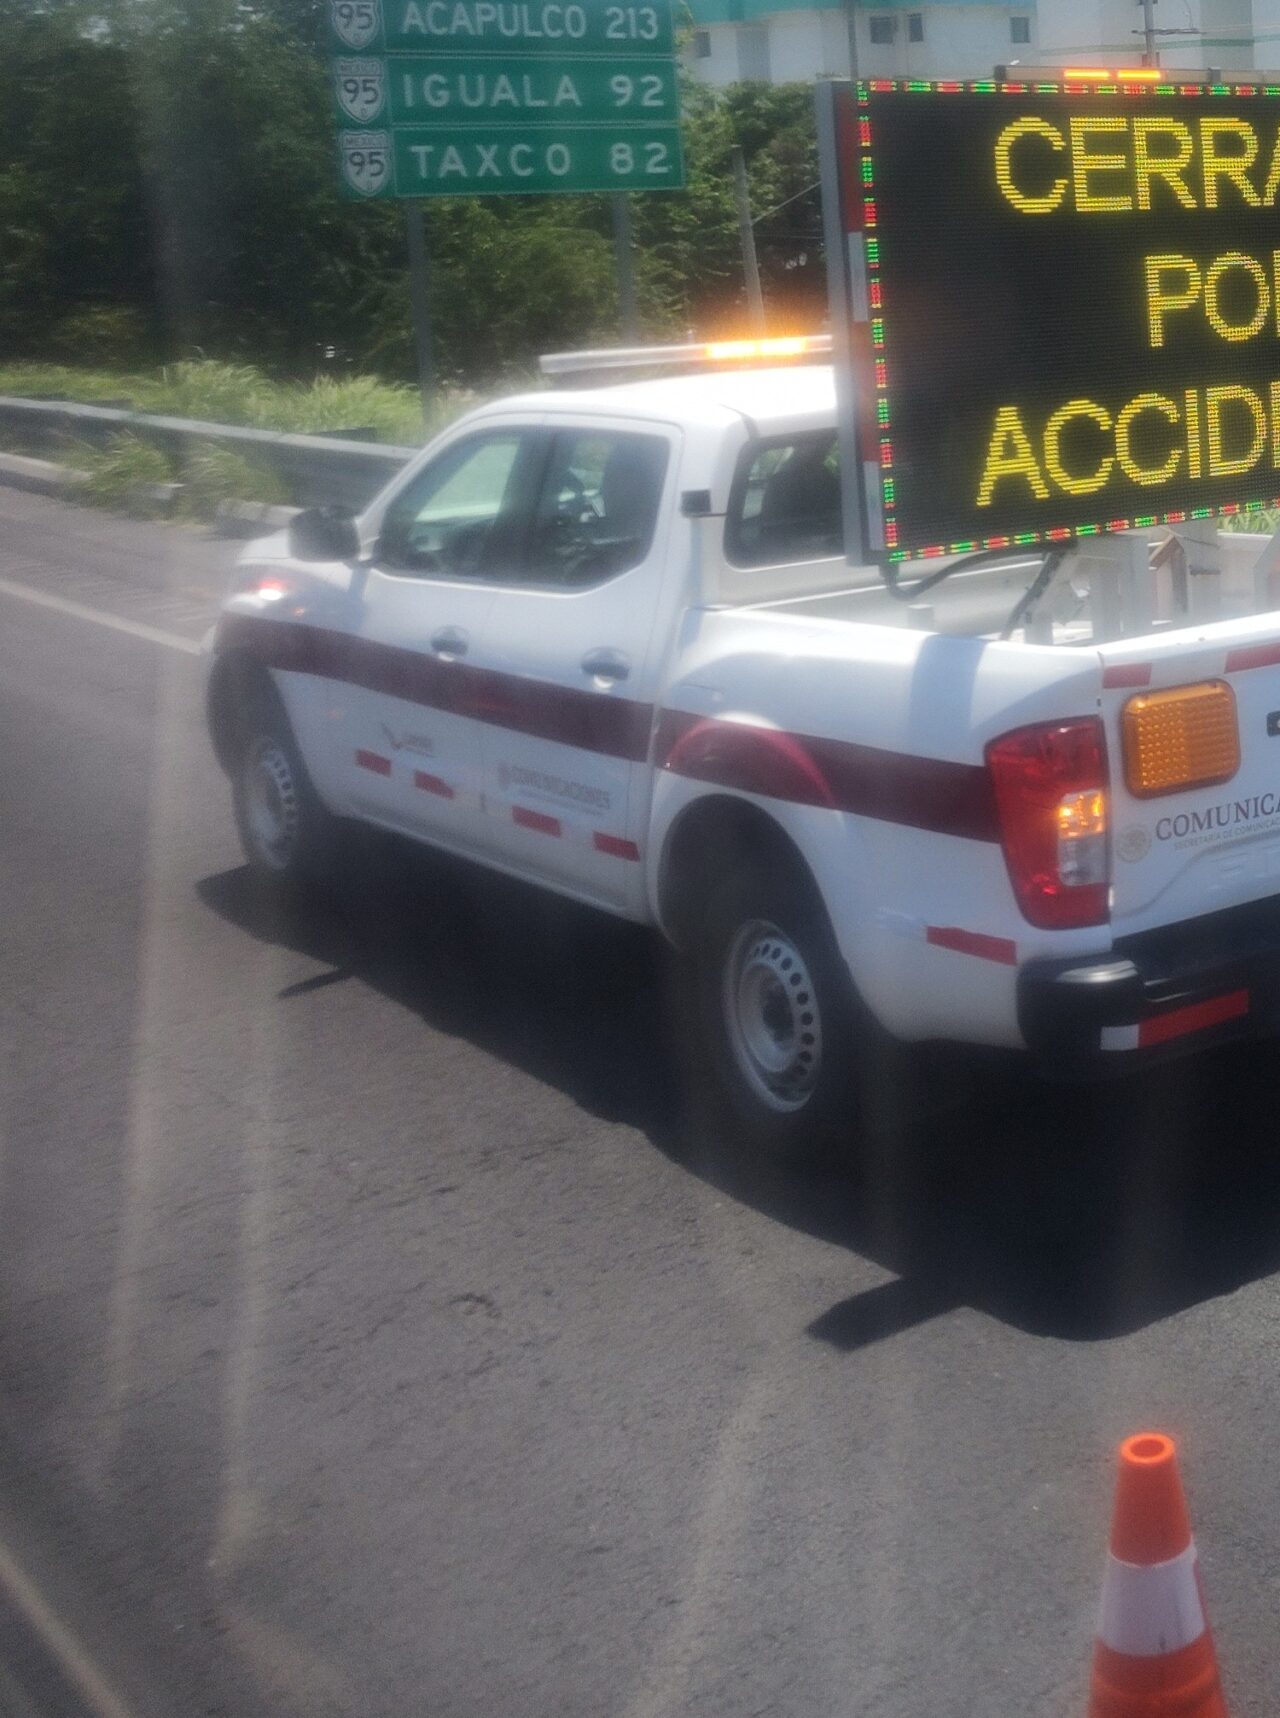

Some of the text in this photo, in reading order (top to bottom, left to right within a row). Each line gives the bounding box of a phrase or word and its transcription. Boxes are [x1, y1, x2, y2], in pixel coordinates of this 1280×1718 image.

[338, 3, 373, 30] 95
[401, 2, 658, 40] ACAPULCO 213
[343, 79, 379, 105] 95
[403, 73, 665, 108] IGUALA 92
[349, 152, 385, 177] 95
[408, 142, 669, 178] TAXCO 82
